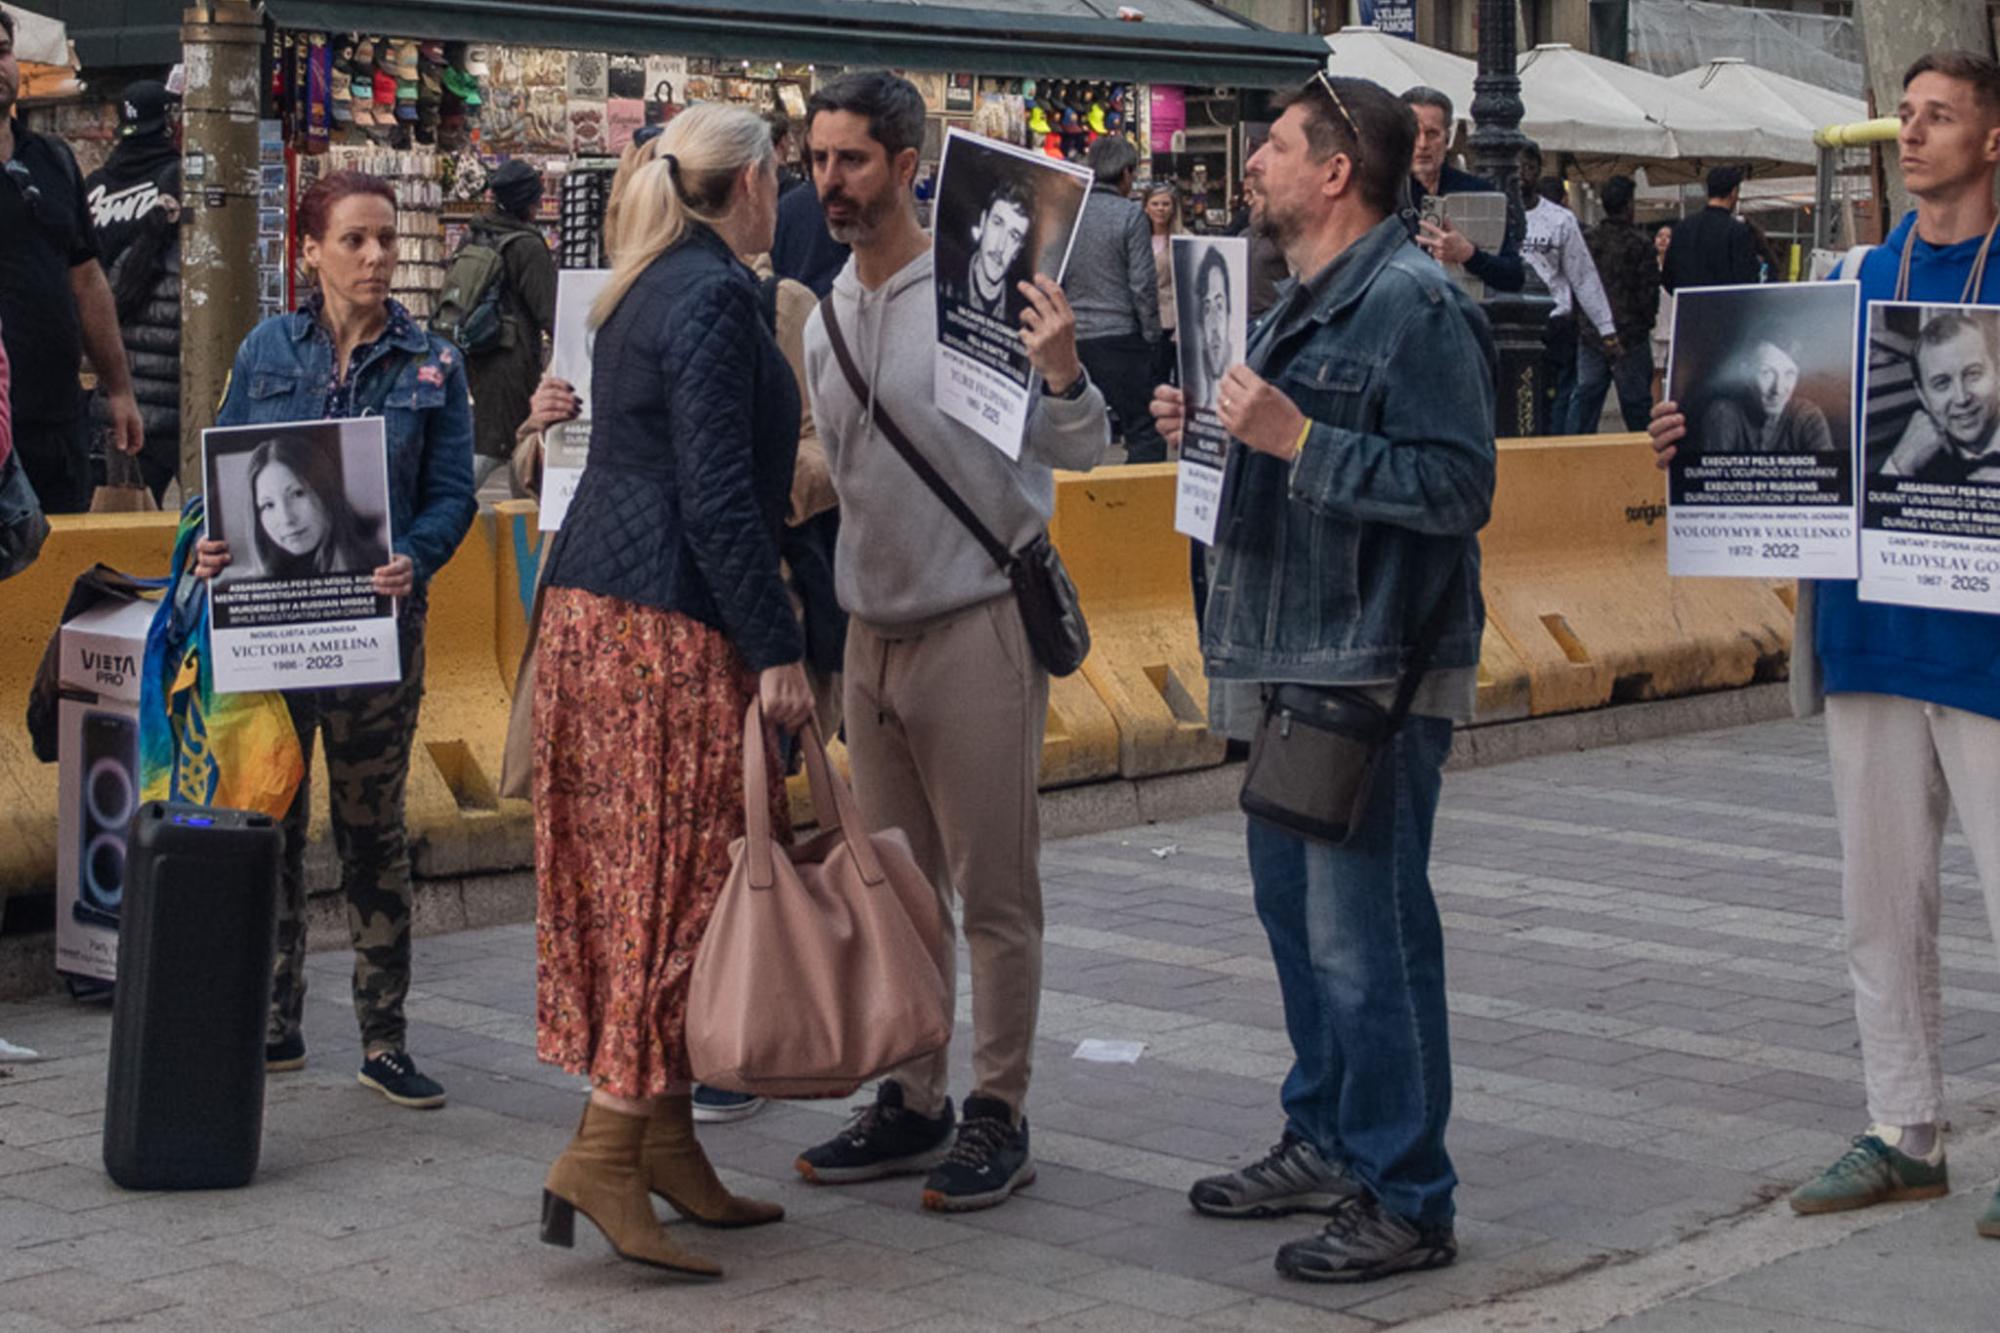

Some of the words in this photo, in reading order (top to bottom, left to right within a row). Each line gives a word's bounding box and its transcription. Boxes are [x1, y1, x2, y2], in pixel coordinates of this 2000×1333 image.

[1672, 525, 1762, 538] VOLODYMYR
[1763, 526, 1851, 539] VAKULENKO
[1761, 543, 1800, 559] 2022
[1880, 550, 1971, 571] VLADYSLAV
[1951, 574, 1991, 593] 2025
[231, 641, 306, 658] VICTORIA
[308, 636, 378, 653] AMELINA
[306, 653, 343, 670] 2023
[96, 670, 124, 688] PRO
